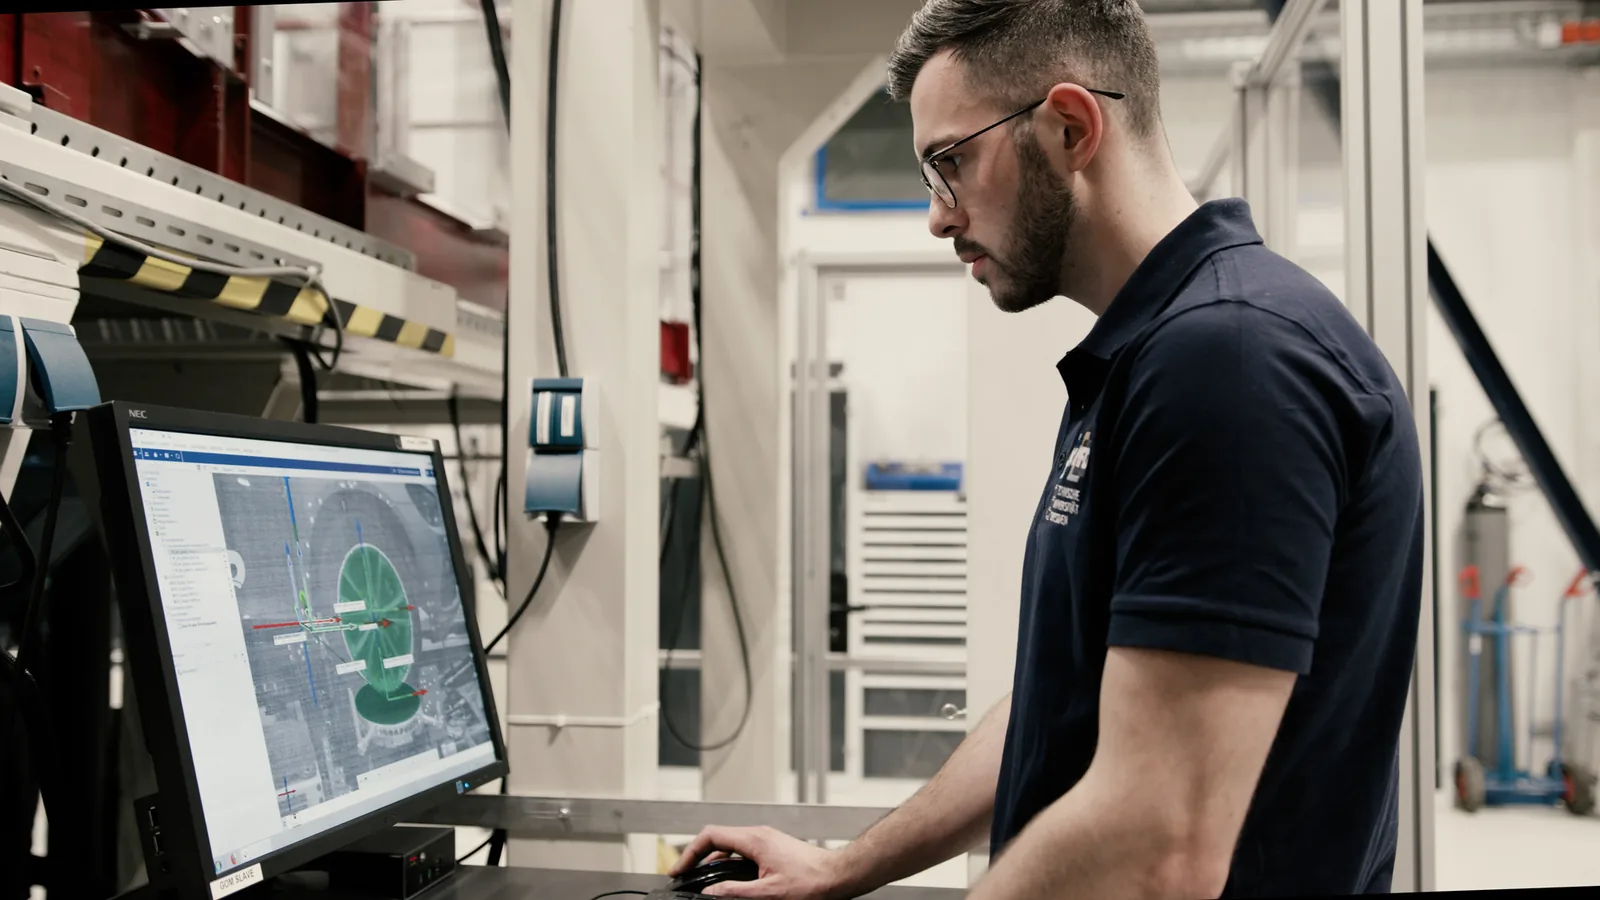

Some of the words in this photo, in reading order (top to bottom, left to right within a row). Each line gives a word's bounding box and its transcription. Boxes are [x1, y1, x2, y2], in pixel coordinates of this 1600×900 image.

[128, 409, 148, 419] NEC
[219, 876, 234, 890] GOM
[234, 868, 256, 884] SLAVE
